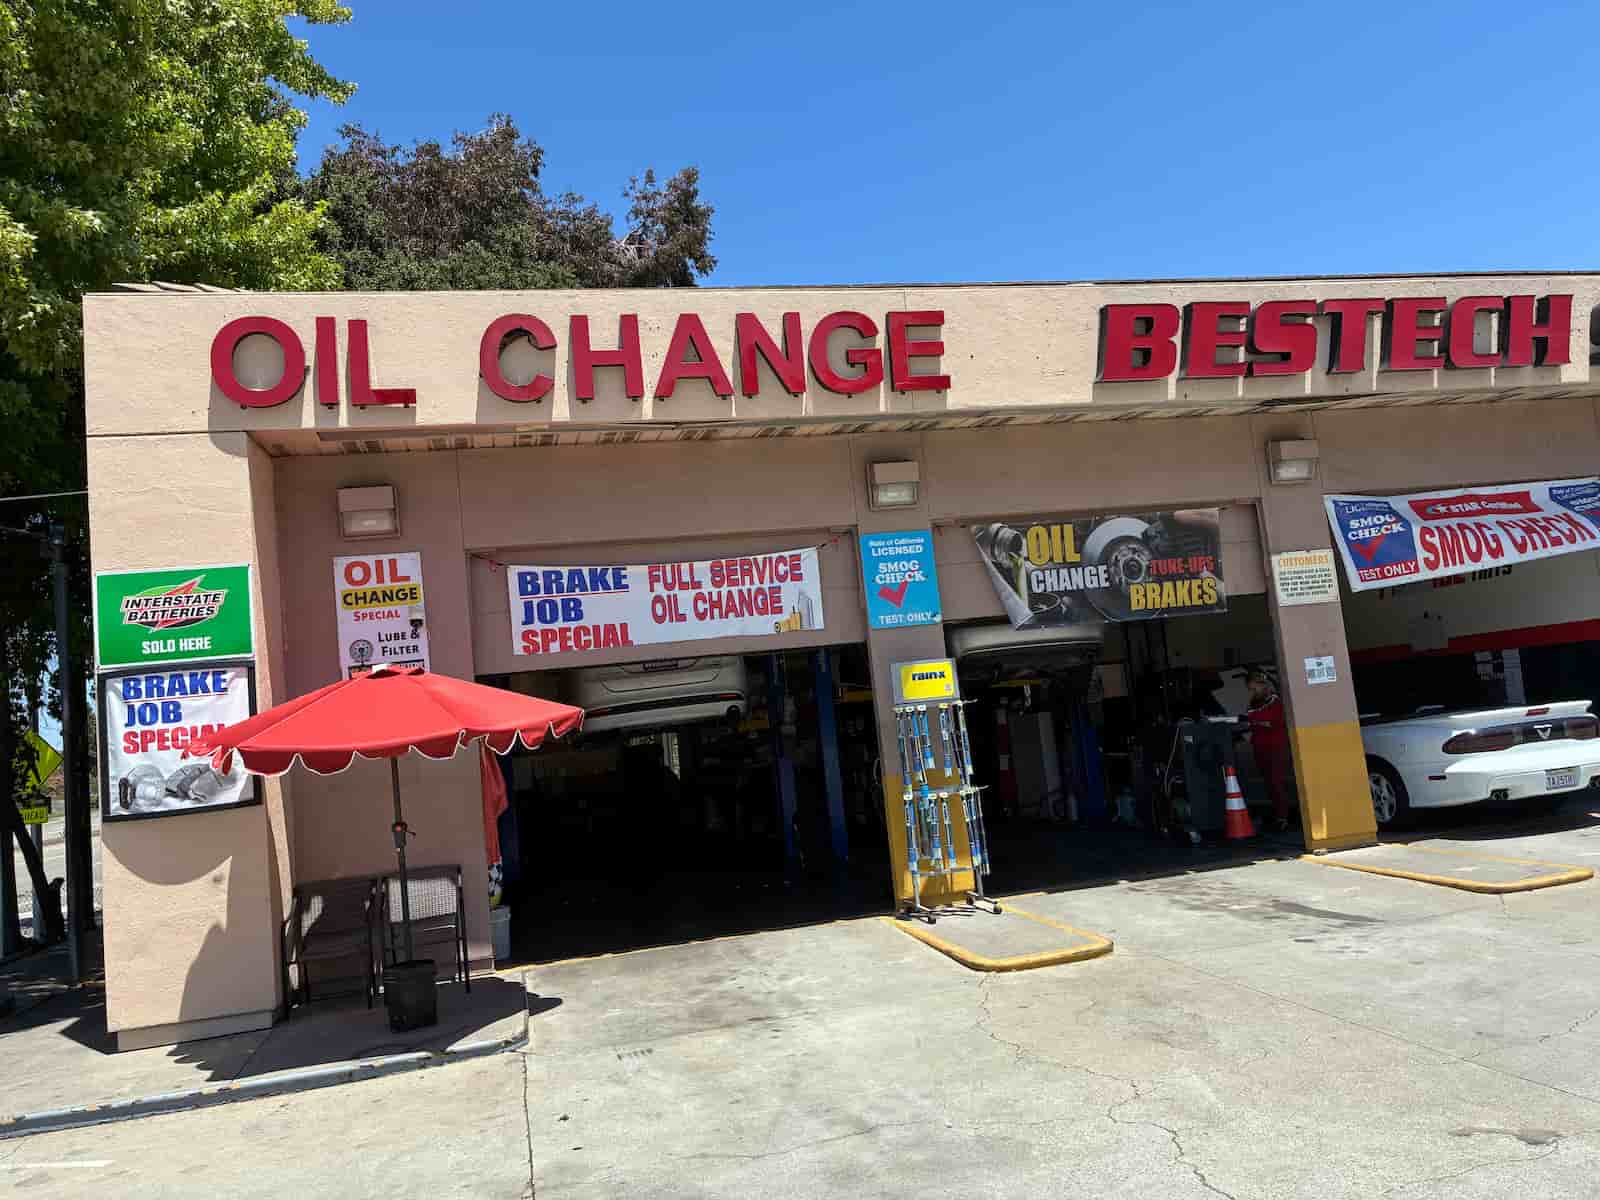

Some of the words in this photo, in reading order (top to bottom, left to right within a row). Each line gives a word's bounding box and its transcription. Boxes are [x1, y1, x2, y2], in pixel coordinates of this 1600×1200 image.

[1097, 294, 1574, 382] BESTECH
[210, 316, 416, 408] OIL
[480, 310, 951, 402] CHANGE
[1348, 522, 1407, 540] CHECK
[1349, 514, 1396, 529] SMOG
[871, 544, 923, 557] LICENSED
[1026, 523, 1081, 566] OIL
[1419, 522, 1505, 572] SMOG
[1496, 511, 1597, 555] CHECK
[344, 558, 411, 586] OIL
[648, 561, 703, 592] FULL
[710, 554, 803, 589] SERVICE
[875, 571, 927, 584] CHECK
[878, 560, 920, 573] SMOG
[1030, 565, 1111, 593] CHANGE
[1150, 556, 1216, 575] TUNE-UPS
[1360, 568, 1382, 580] TEST
[1384, 561, 1416, 576] ONLY
[517, 567, 630, 597] BRAKE
[1129, 577, 1217, 610] BRAKES
[125, 591, 224, 609] INTERSTATE
[343, 587, 419, 606] CHANGE
[651, 593, 687, 624] OIL
[693, 586, 784, 622] CHANGE
[127, 606, 216, 622] BATTERIES
[353, 609, 401, 622] SPECIAL
[521, 598, 584, 625] JOB
[879, 613, 905, 625] TEST
[907, 611, 932, 622] ONLY
[142, 639, 176, 654] SOLD
[179, 637, 212, 651] HERE
[521, 623, 634, 655] SPECIAL
[122, 670, 229, 700] BRAKE
[124, 700, 183, 727] JOB
[123, 723, 225, 754] SPECI
